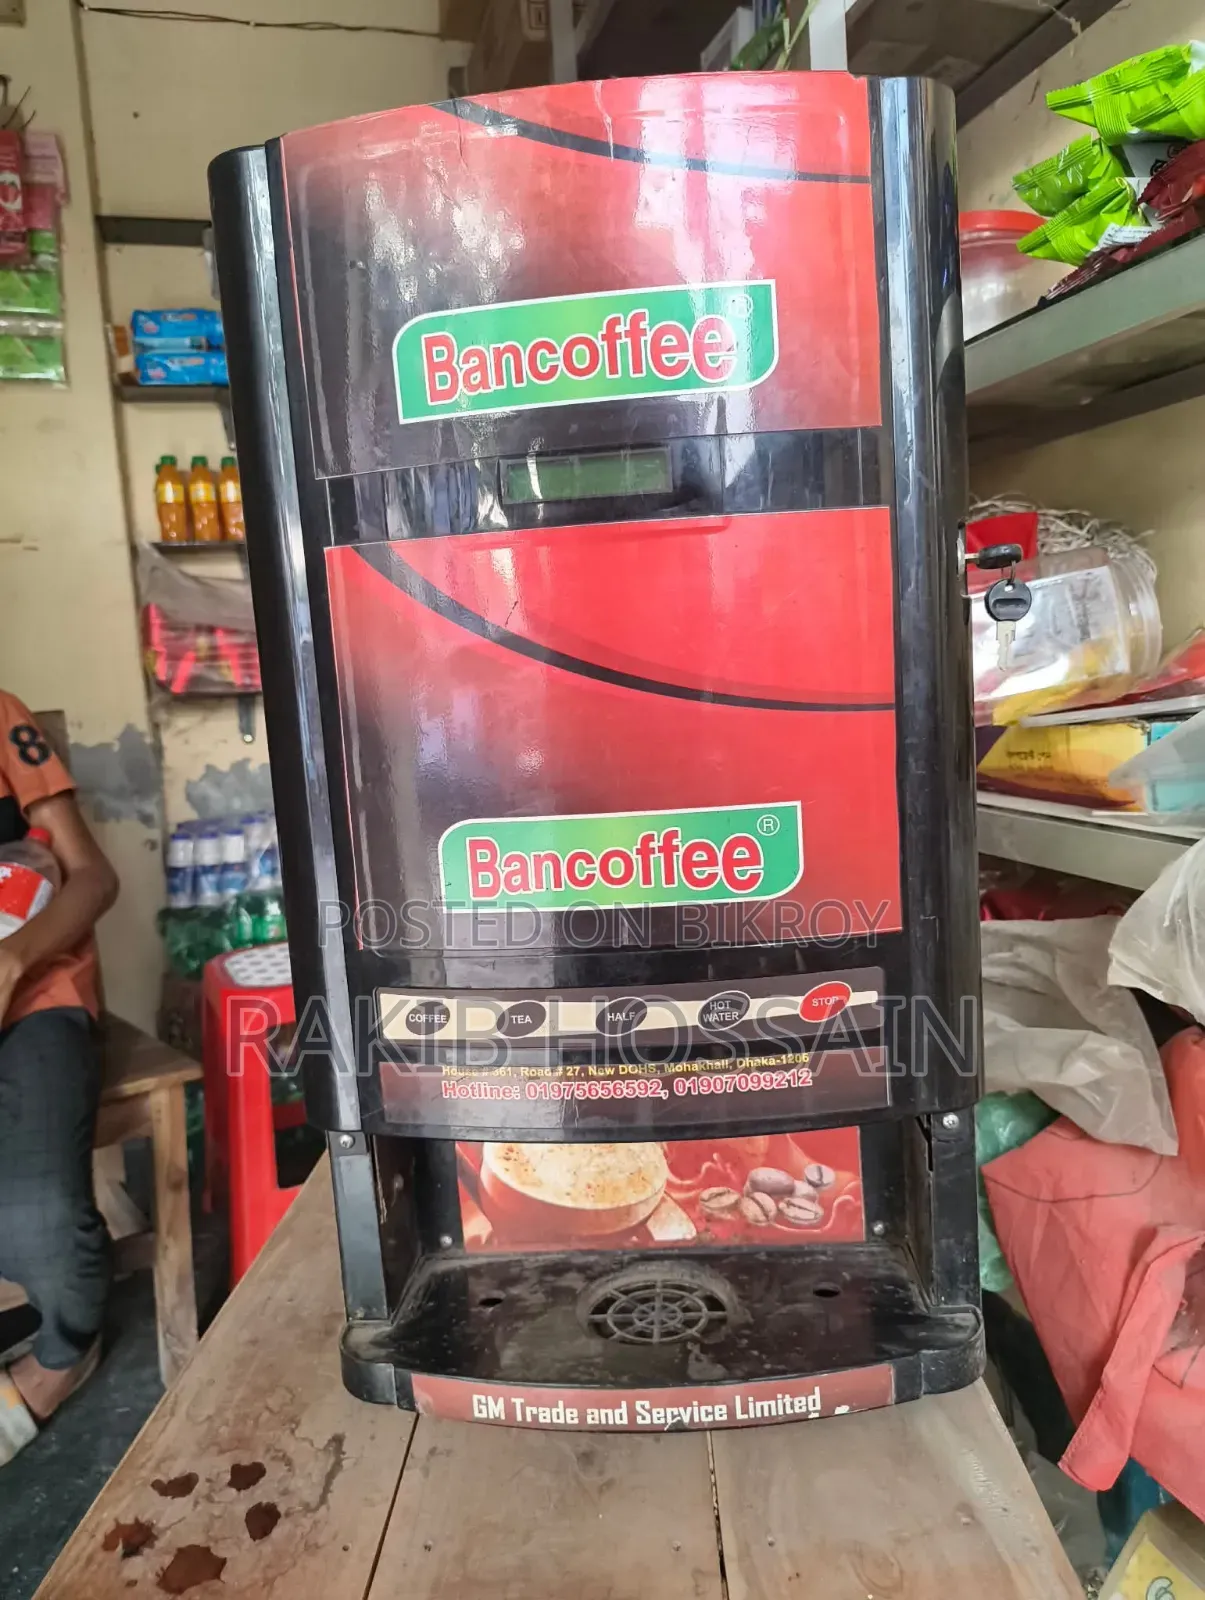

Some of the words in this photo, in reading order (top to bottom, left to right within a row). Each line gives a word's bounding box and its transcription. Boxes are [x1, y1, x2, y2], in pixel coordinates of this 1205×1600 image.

[422, 310, 737, 405] Bancoffee
[9, 724, 49, 766] 8
[466, 828, 764, 900] Bancoffee
[710, 1000, 731, 1010] HOT
[811, 996, 839, 1007] STOP
[408, 1013, 448, 1024] COFFEE
[510, 1014, 533, 1025] TEA
[607, 1011, 636, 1022] HALF
[703, 1011, 739, 1022] WATER
[520, 1066, 551, 1077] Road
[566, 1066, 585, 1078] 27,
[588, 1065, 616, 1076] New
[618, 1063, 660, 1075] DOHS,
[736, 1052, 810, 1068] Dhaka-1206
[441, 1080, 520, 1099] Hotline:
[526, 1078, 668, 1100] 01975656592,
[673, 1068, 813, 1096] 01907099212
[472, 1394, 506, 1420] GM
[511, 1397, 579, 1423] Trade
[586, 1400, 628, 1425] and
[635, 1400, 728, 1425] Service
[734, 1386, 821, 1420] Limited
